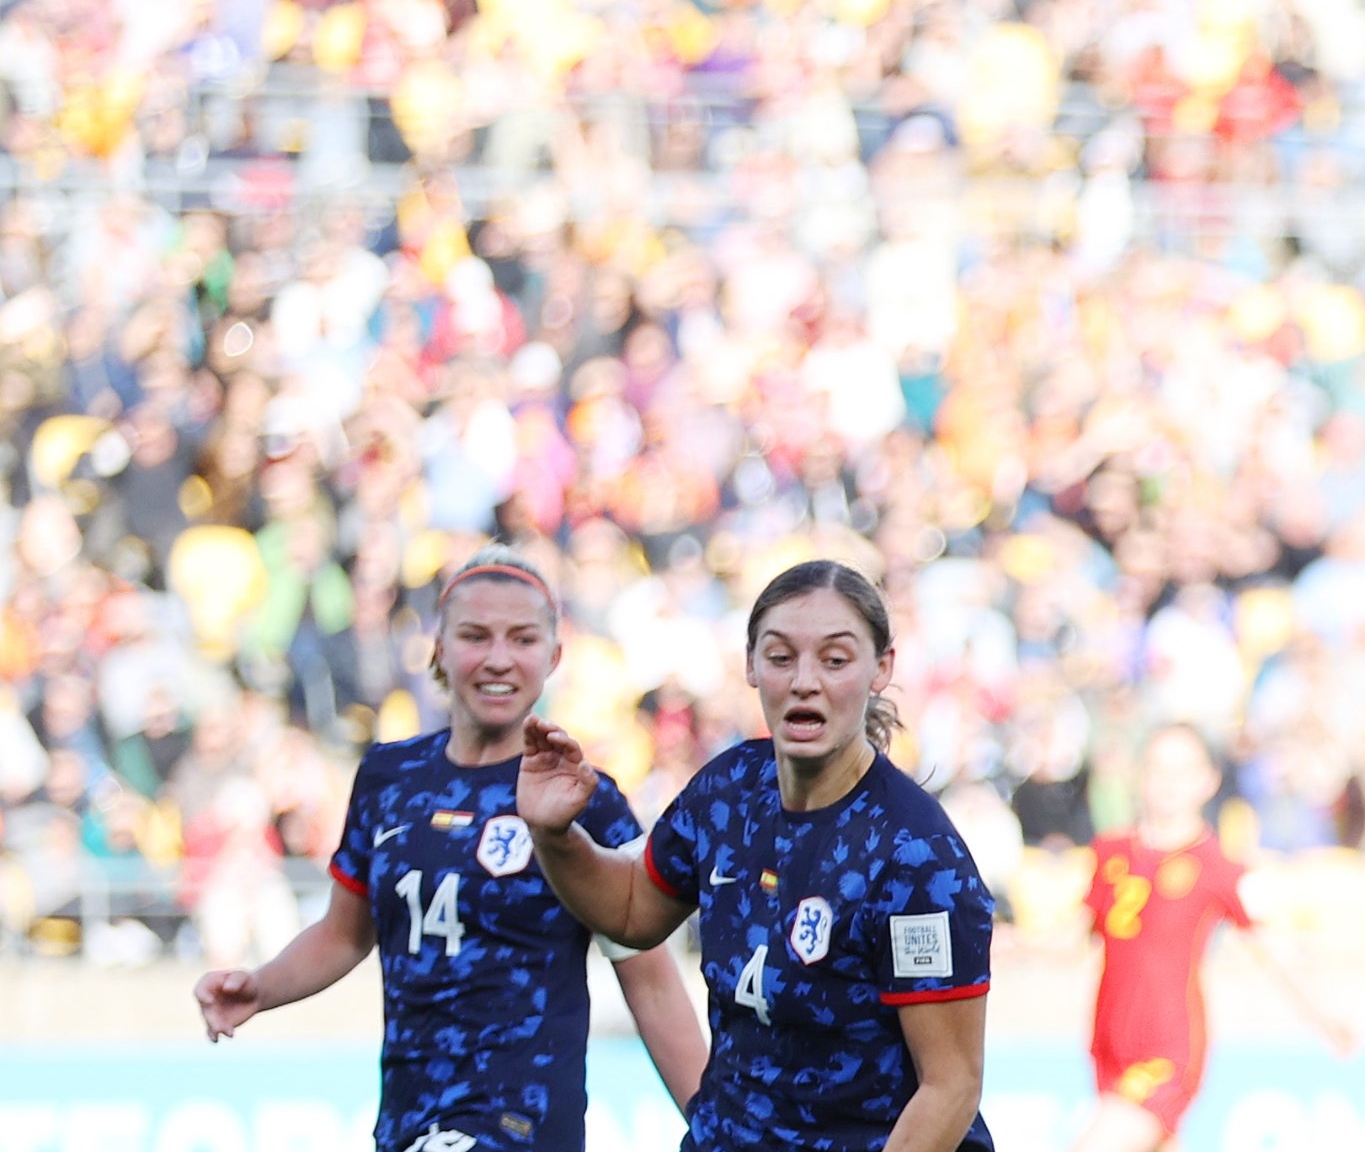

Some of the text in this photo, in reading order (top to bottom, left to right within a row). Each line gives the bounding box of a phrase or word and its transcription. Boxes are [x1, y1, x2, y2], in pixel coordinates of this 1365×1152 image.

[395, 869, 465, 957] 14
[904, 932, 938, 946] UNITES
[1105, 875, 1152, 940] 2
[735, 944, 772, 1027] 4
